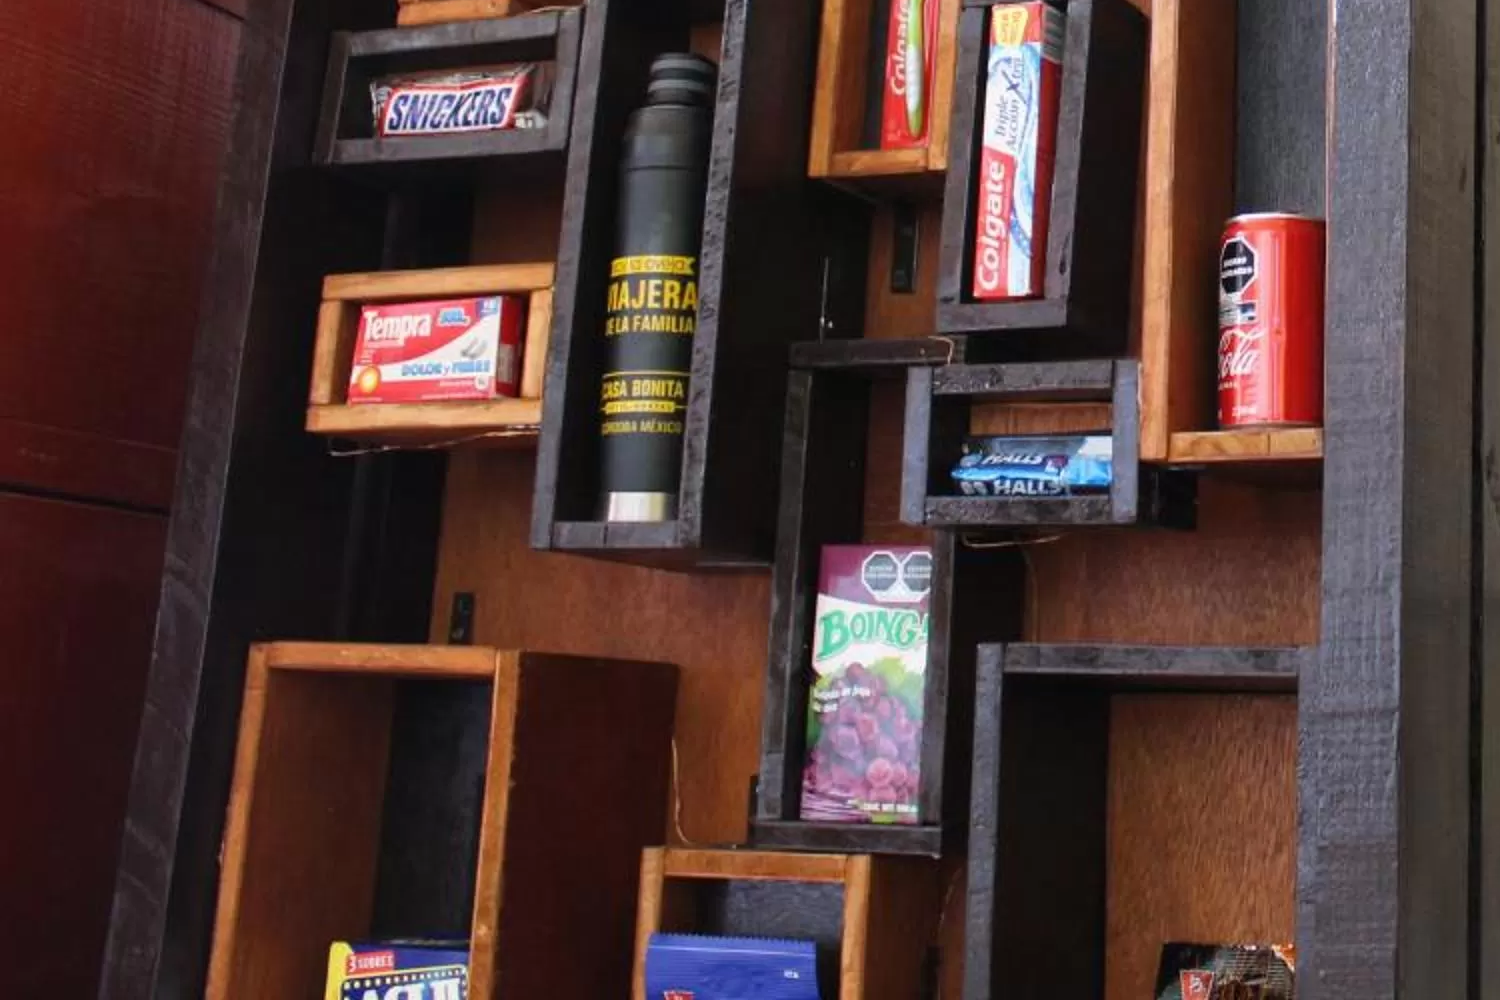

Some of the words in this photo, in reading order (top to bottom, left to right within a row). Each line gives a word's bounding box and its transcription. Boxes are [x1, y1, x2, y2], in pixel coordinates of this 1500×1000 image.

[388, 88, 512, 130] SNICKERS
[979, 161, 1006, 291] Colgate
[364, 311, 432, 346] Tempra
[633, 315, 693, 334] FAMILIA
[631, 379, 684, 398] BONITA
